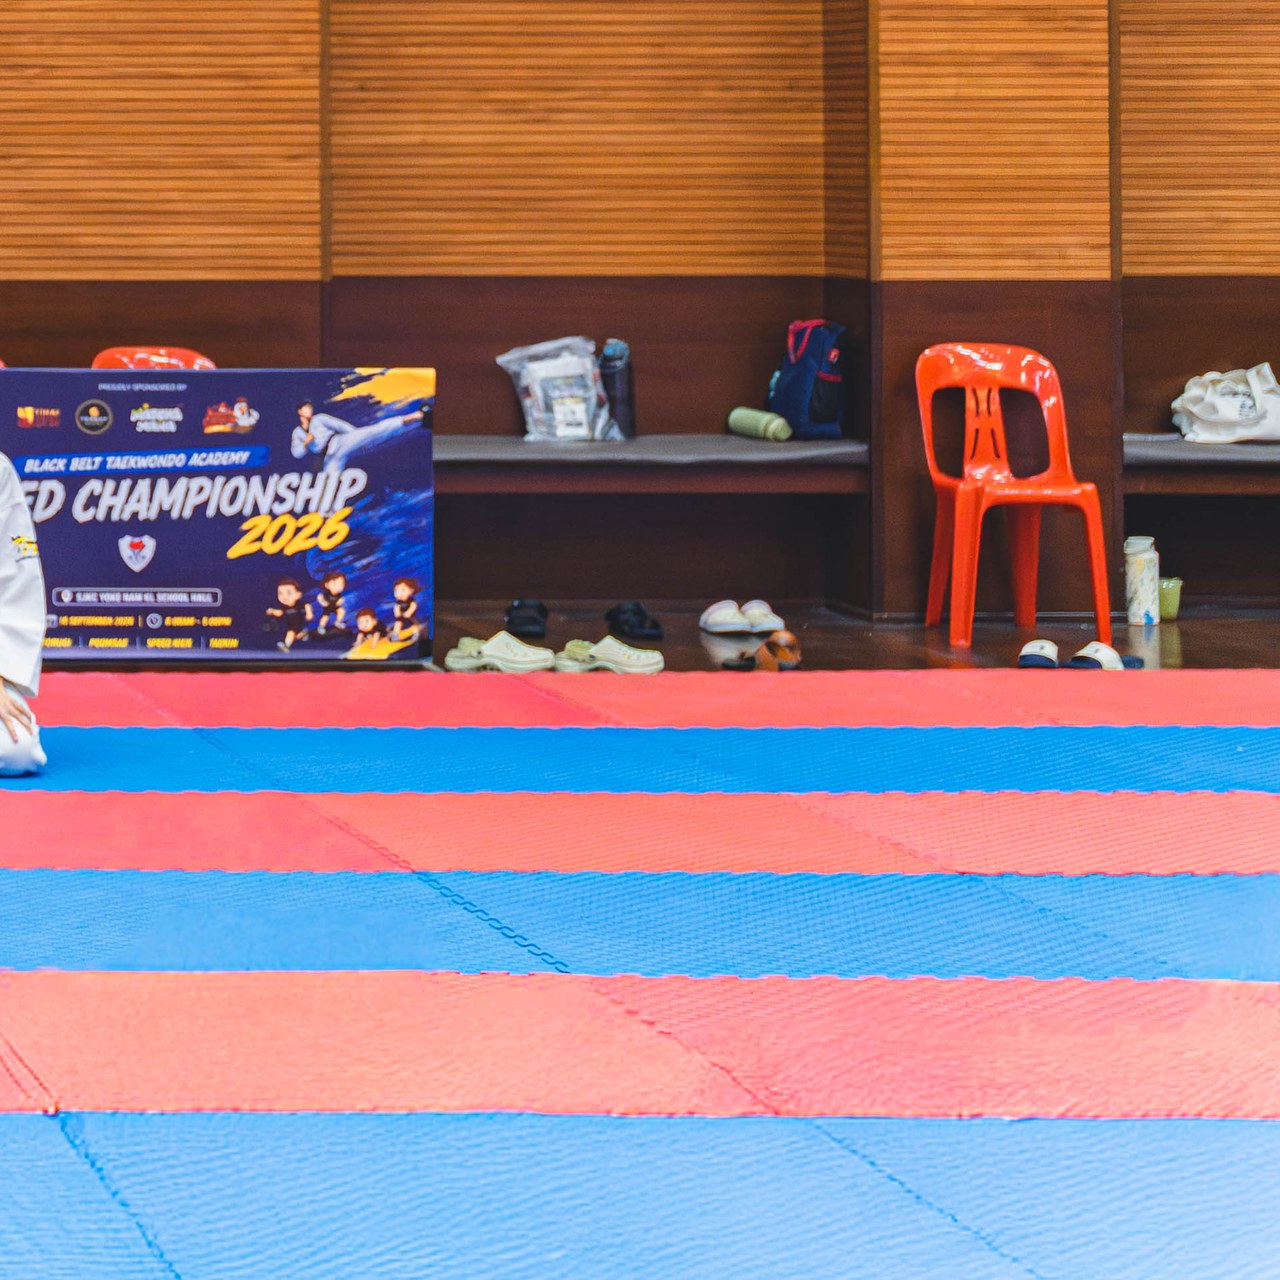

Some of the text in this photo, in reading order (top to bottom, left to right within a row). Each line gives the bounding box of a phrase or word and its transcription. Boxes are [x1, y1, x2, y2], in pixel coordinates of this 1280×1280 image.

[24, 450, 251, 474] BLACK BELT TAEKWONDO ACADEMY
[71, 467, 369, 524] CHAMPIONSHIP
[226, 506, 355, 560] 2026
[156, 591, 189, 603] SCHOOL
